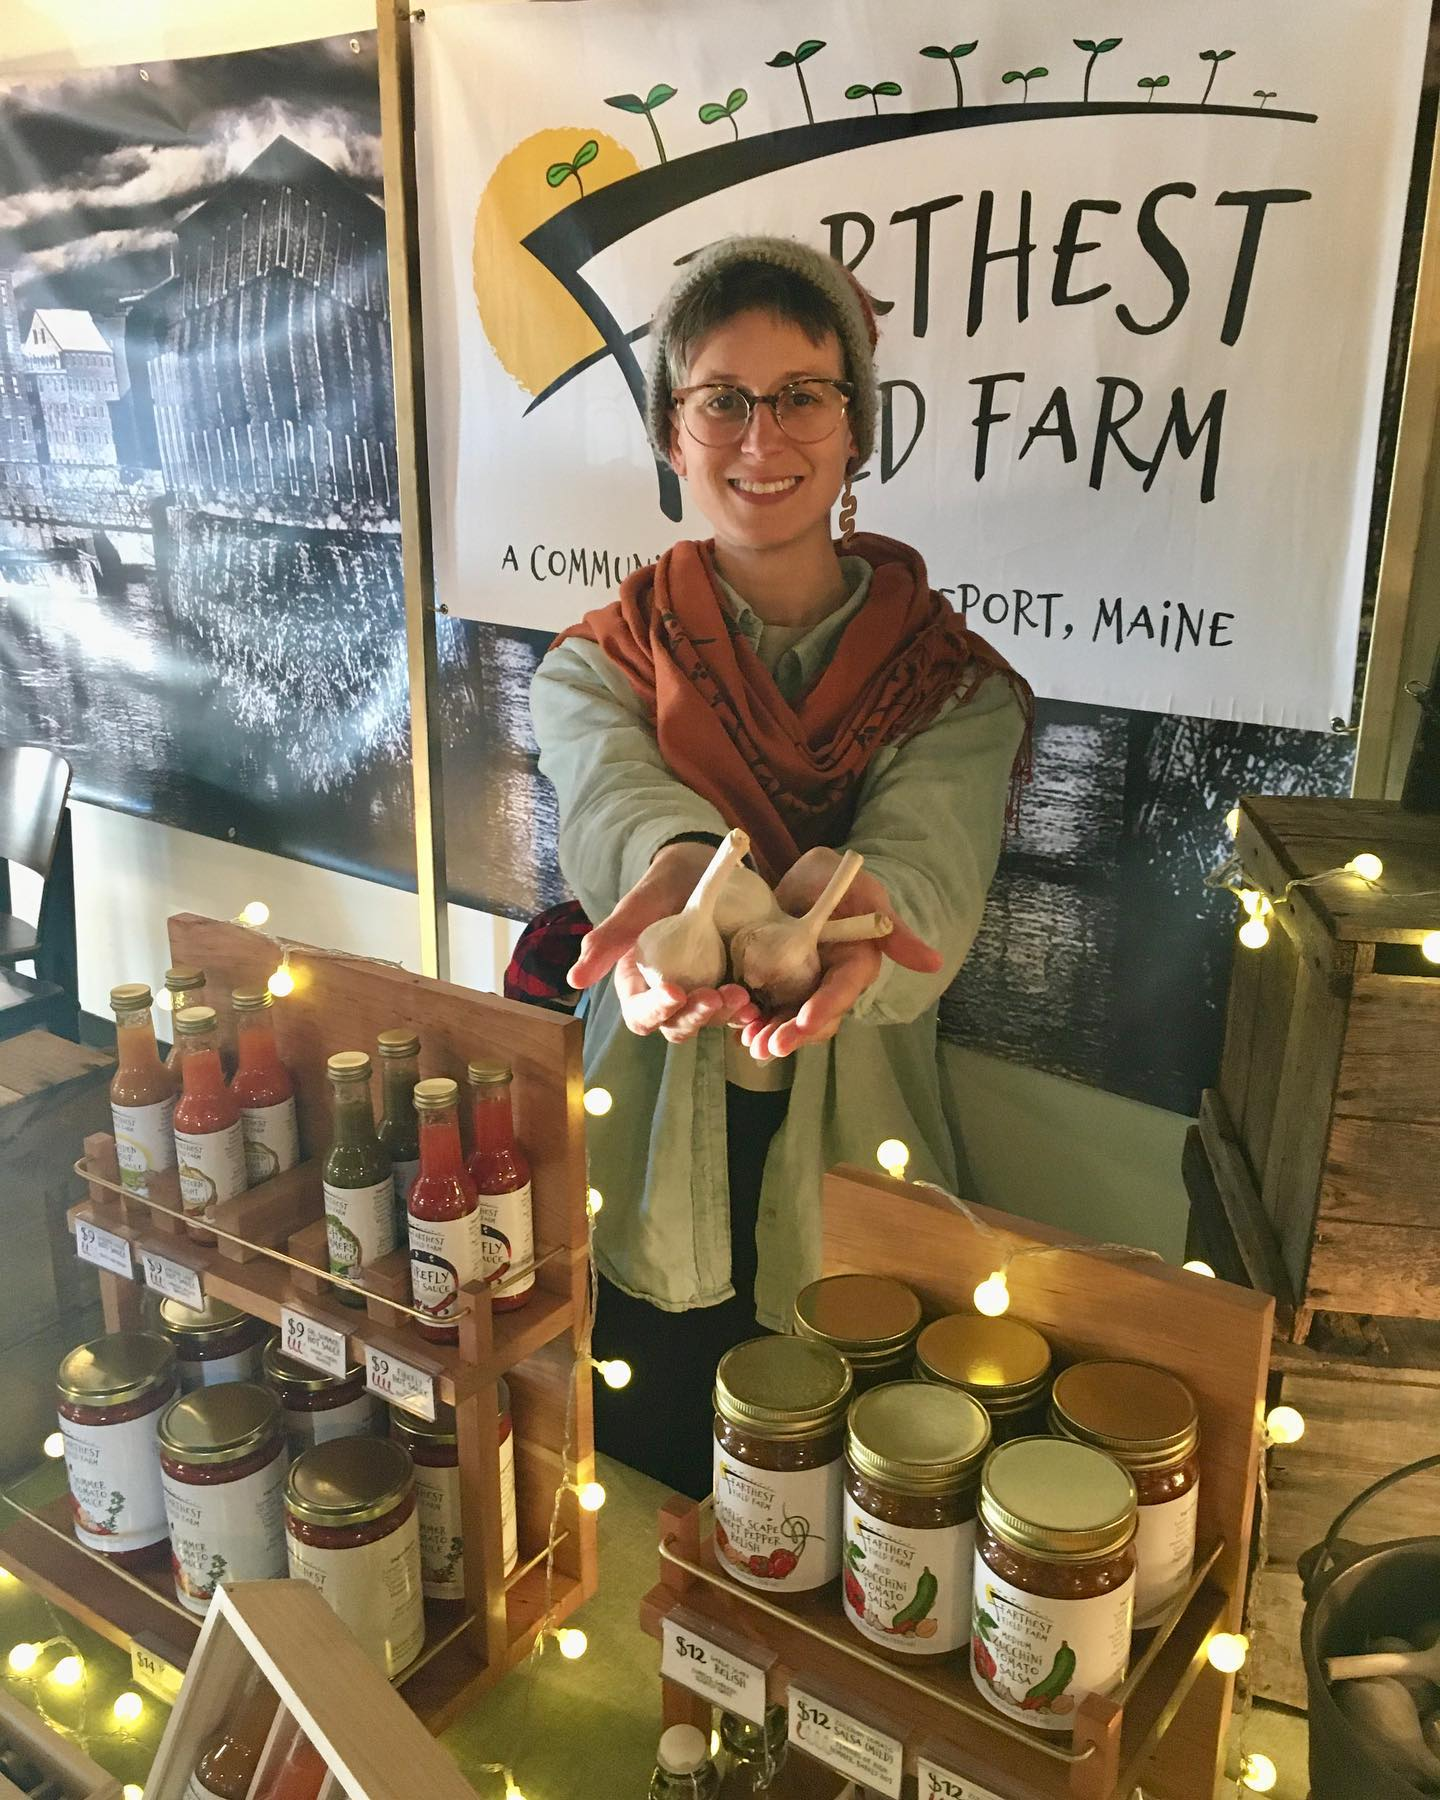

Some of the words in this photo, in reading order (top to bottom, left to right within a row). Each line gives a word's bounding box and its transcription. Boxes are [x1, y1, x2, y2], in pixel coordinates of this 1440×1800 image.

[968, 372, 1227, 503] FARM
[502, 545, 519, 571] A
[80, 1226, 95, 1243] $9
[422, 1282, 451, 1294] SAUCE
[288, 1317, 305, 1338] $9
[371, 1355, 389, 1376] $9
[744, 1528, 782, 1547] PEPPER
[747, 1519, 779, 1535] SCAPE
[890, 1555, 911, 1569] FARM
[864, 1576, 905, 1602] TOMATO
[867, 1591, 898, 1611] SALSA
[997, 1602, 1053, 1635] FARTHEST
[1025, 1627, 1049, 1642] FARM
[675, 1635, 707, 1664] $12
[995, 1647, 1040, 1675] TOMATO
[1000, 1663, 1032, 1686] SALSA
[797, 1700, 831, 1730] $12
[834, 1726, 862, 1747] SALSA
[928, 1772, 964, 1800] $12
